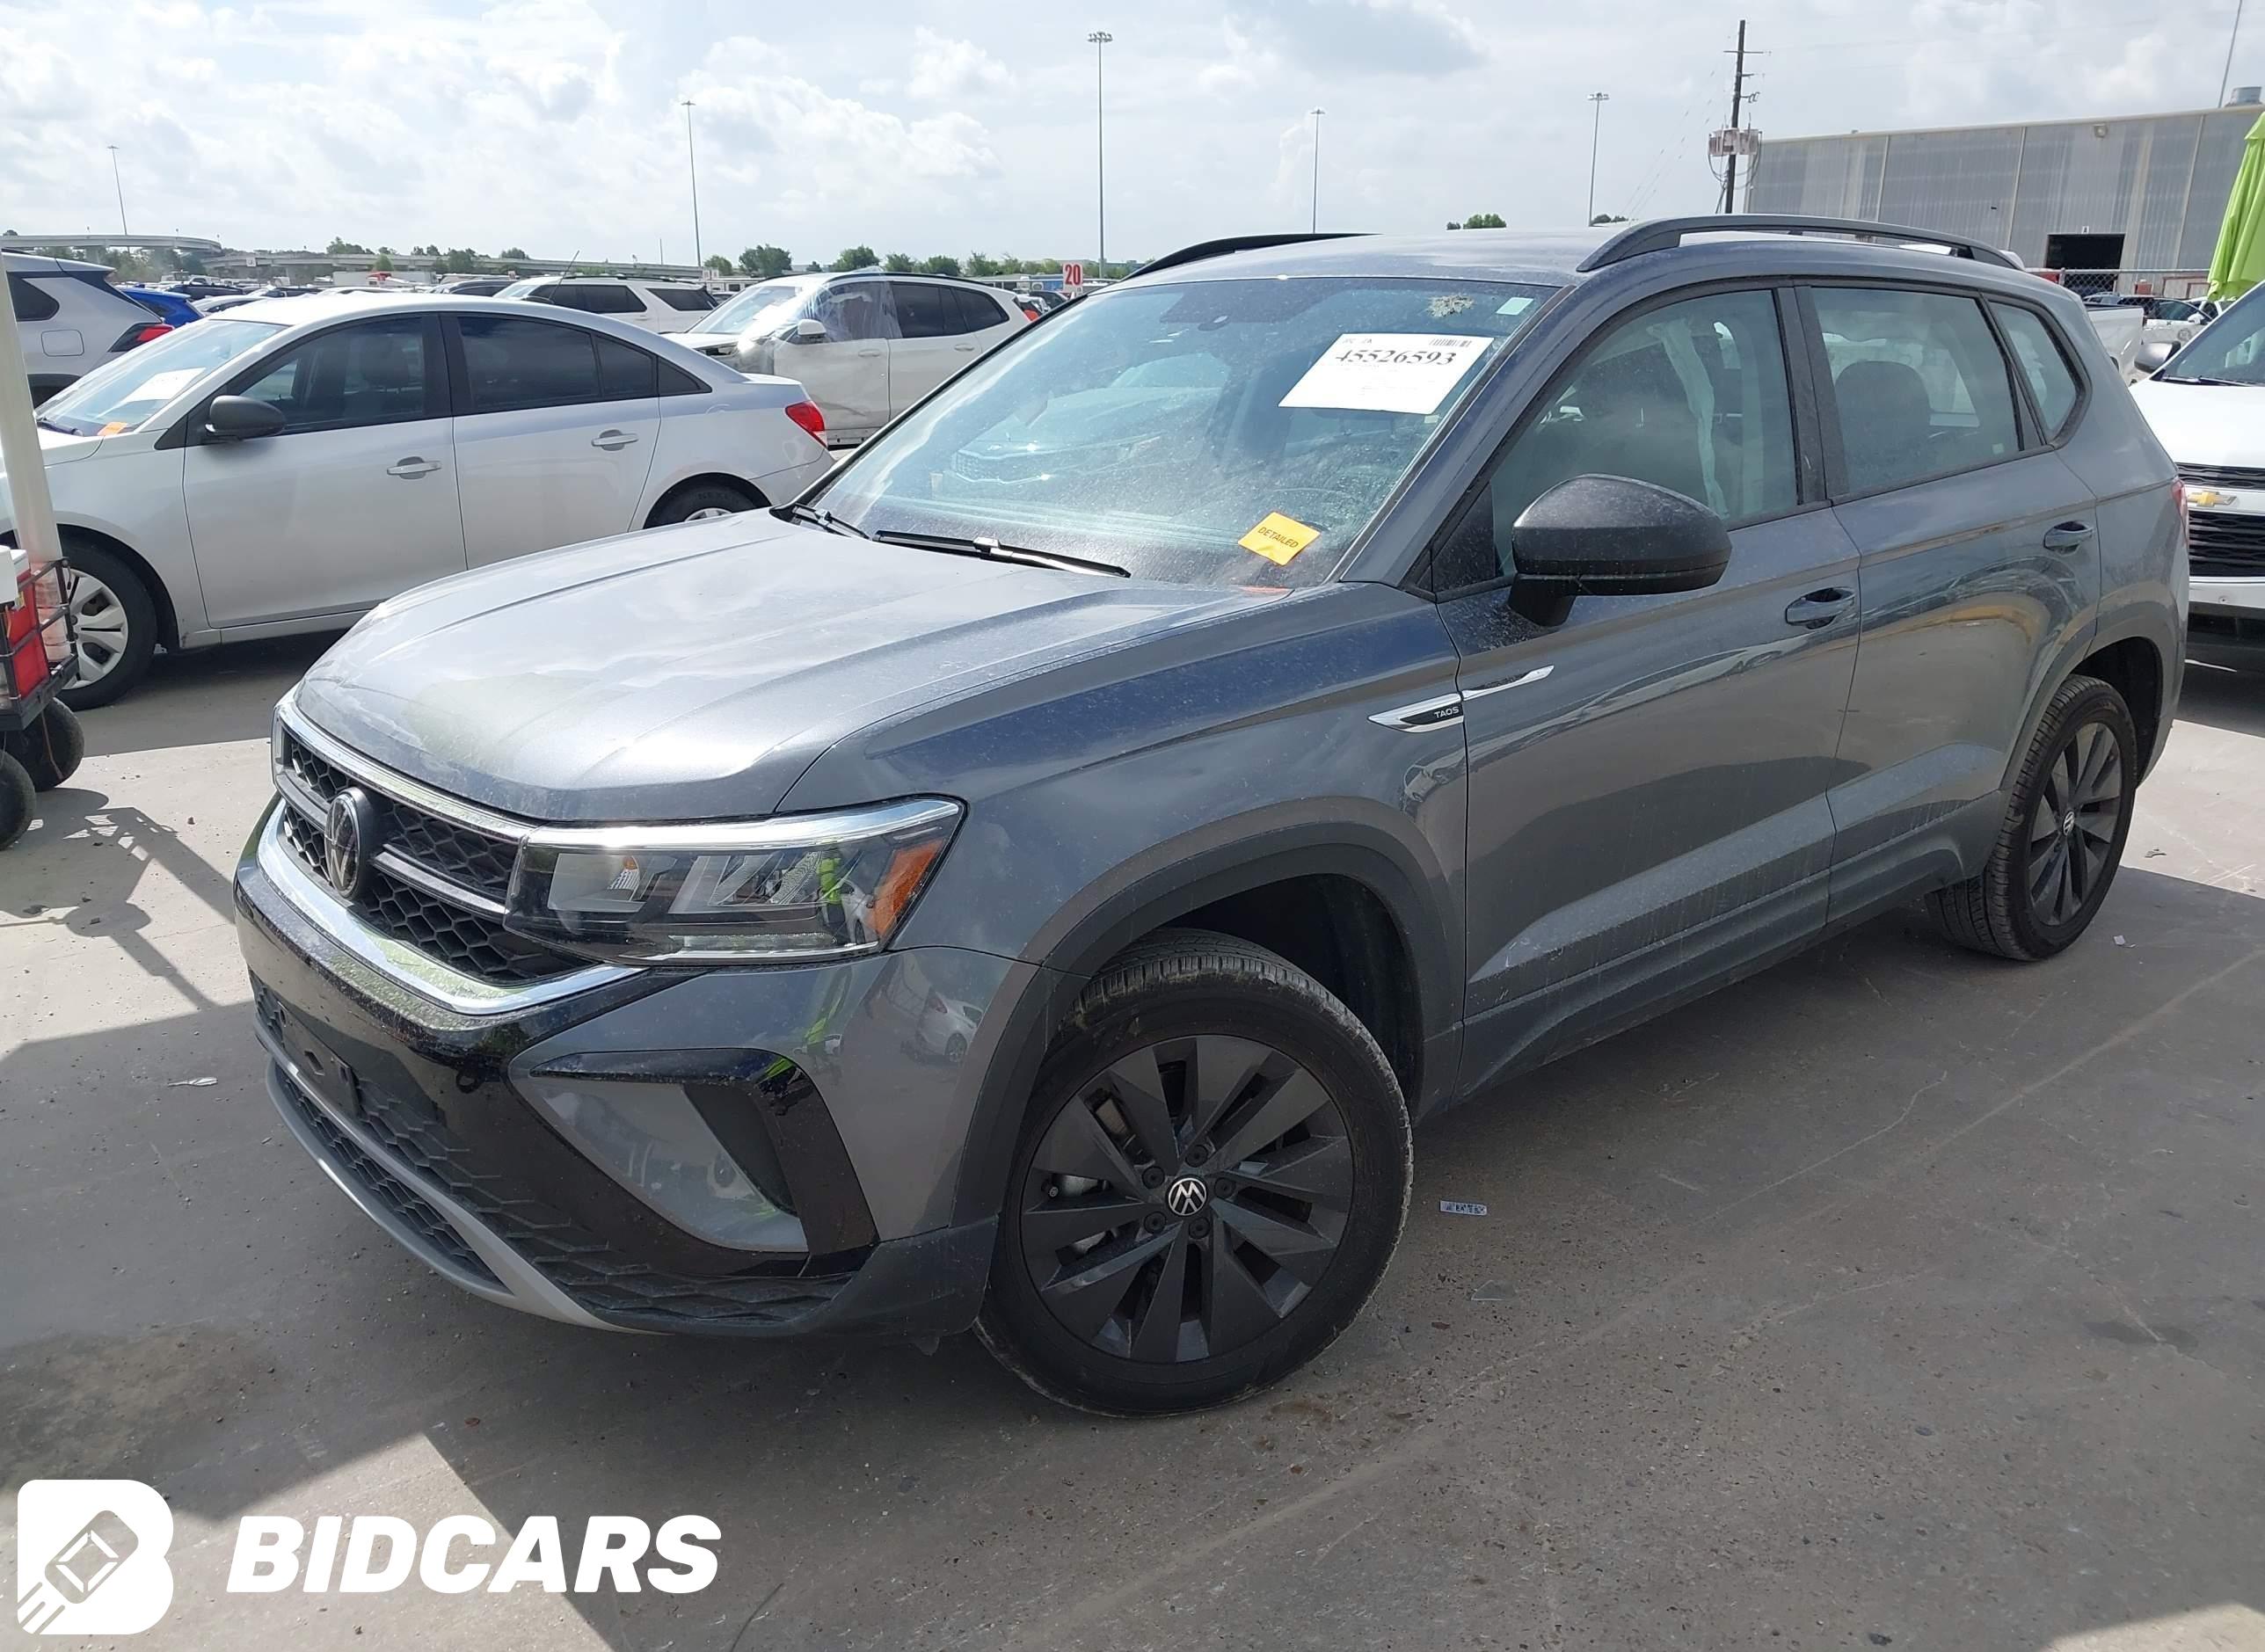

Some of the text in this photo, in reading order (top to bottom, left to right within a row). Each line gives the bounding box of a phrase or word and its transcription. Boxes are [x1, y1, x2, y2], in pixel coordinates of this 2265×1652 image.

[1065, 264, 1081, 286] 20
[1335, 349, 1457, 366] 45526593
[1257, 527, 1300, 549] DETAILED
[1434, 706, 1460, 719] TAOS
